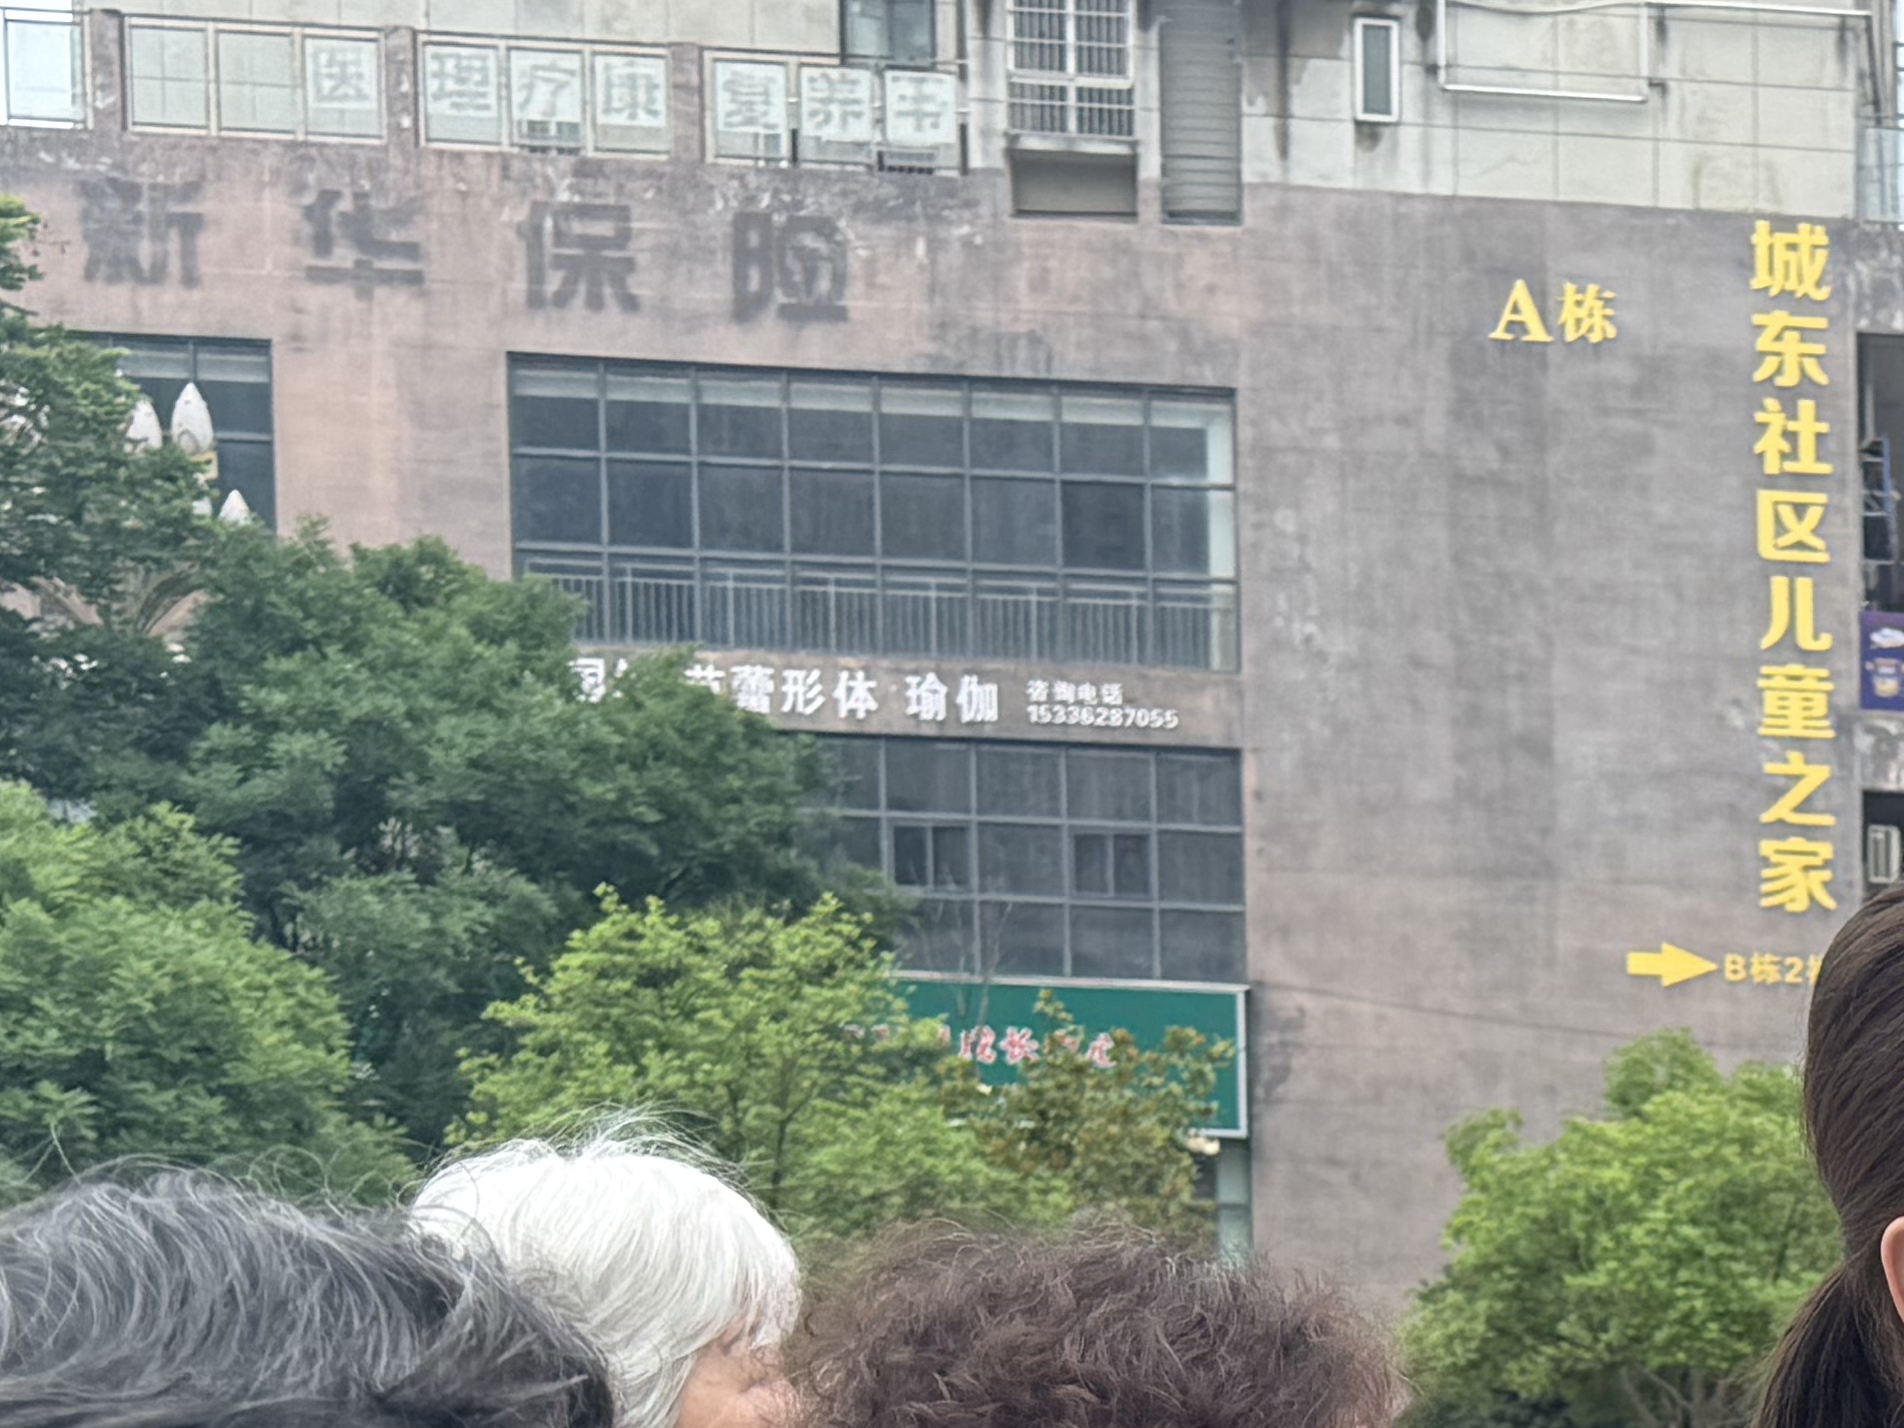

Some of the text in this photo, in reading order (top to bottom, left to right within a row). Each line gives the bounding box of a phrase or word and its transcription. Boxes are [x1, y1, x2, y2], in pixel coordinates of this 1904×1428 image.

[1489, 279, 1618, 342] A栋
[1750, 221, 1836, 913] 城东社区儿童之家
